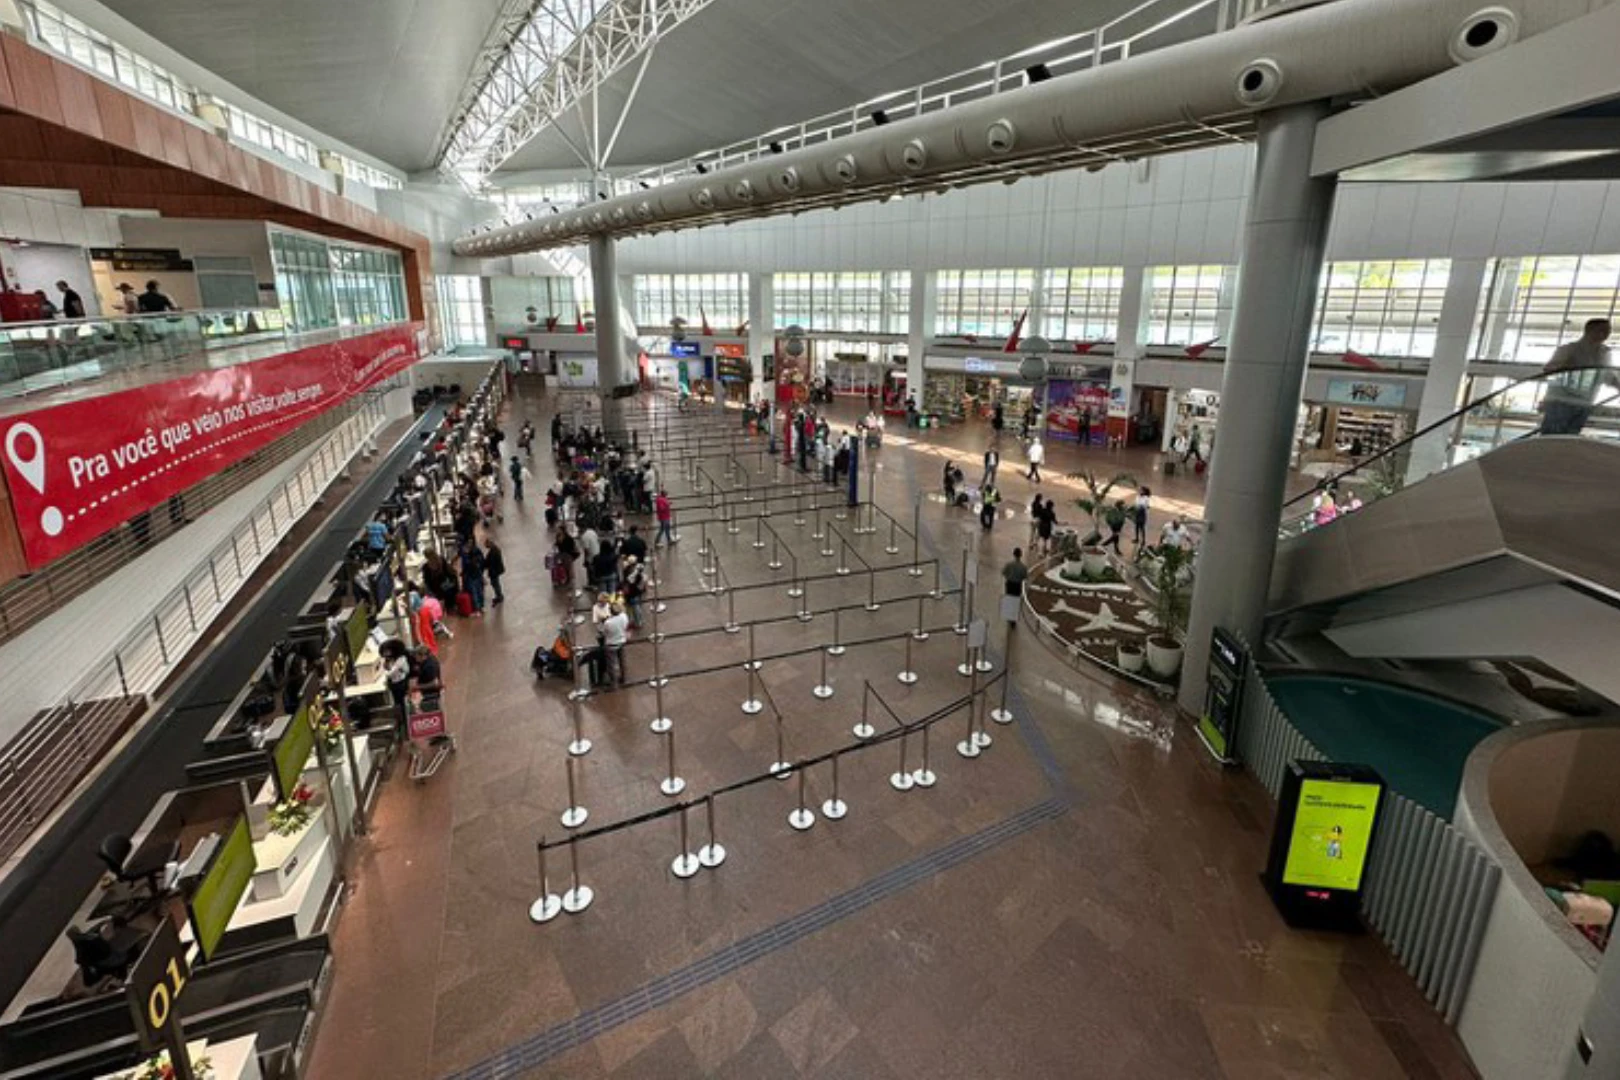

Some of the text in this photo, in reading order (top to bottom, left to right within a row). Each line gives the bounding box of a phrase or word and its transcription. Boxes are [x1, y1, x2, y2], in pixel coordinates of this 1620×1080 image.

[67, 453, 110, 489] Pra
[112, 427, 158, 469] você
[161, 422, 192, 454] que
[192, 407, 222, 434] veio
[223, 403, 246, 424] nos
[149, 956, 187, 1029] 01
